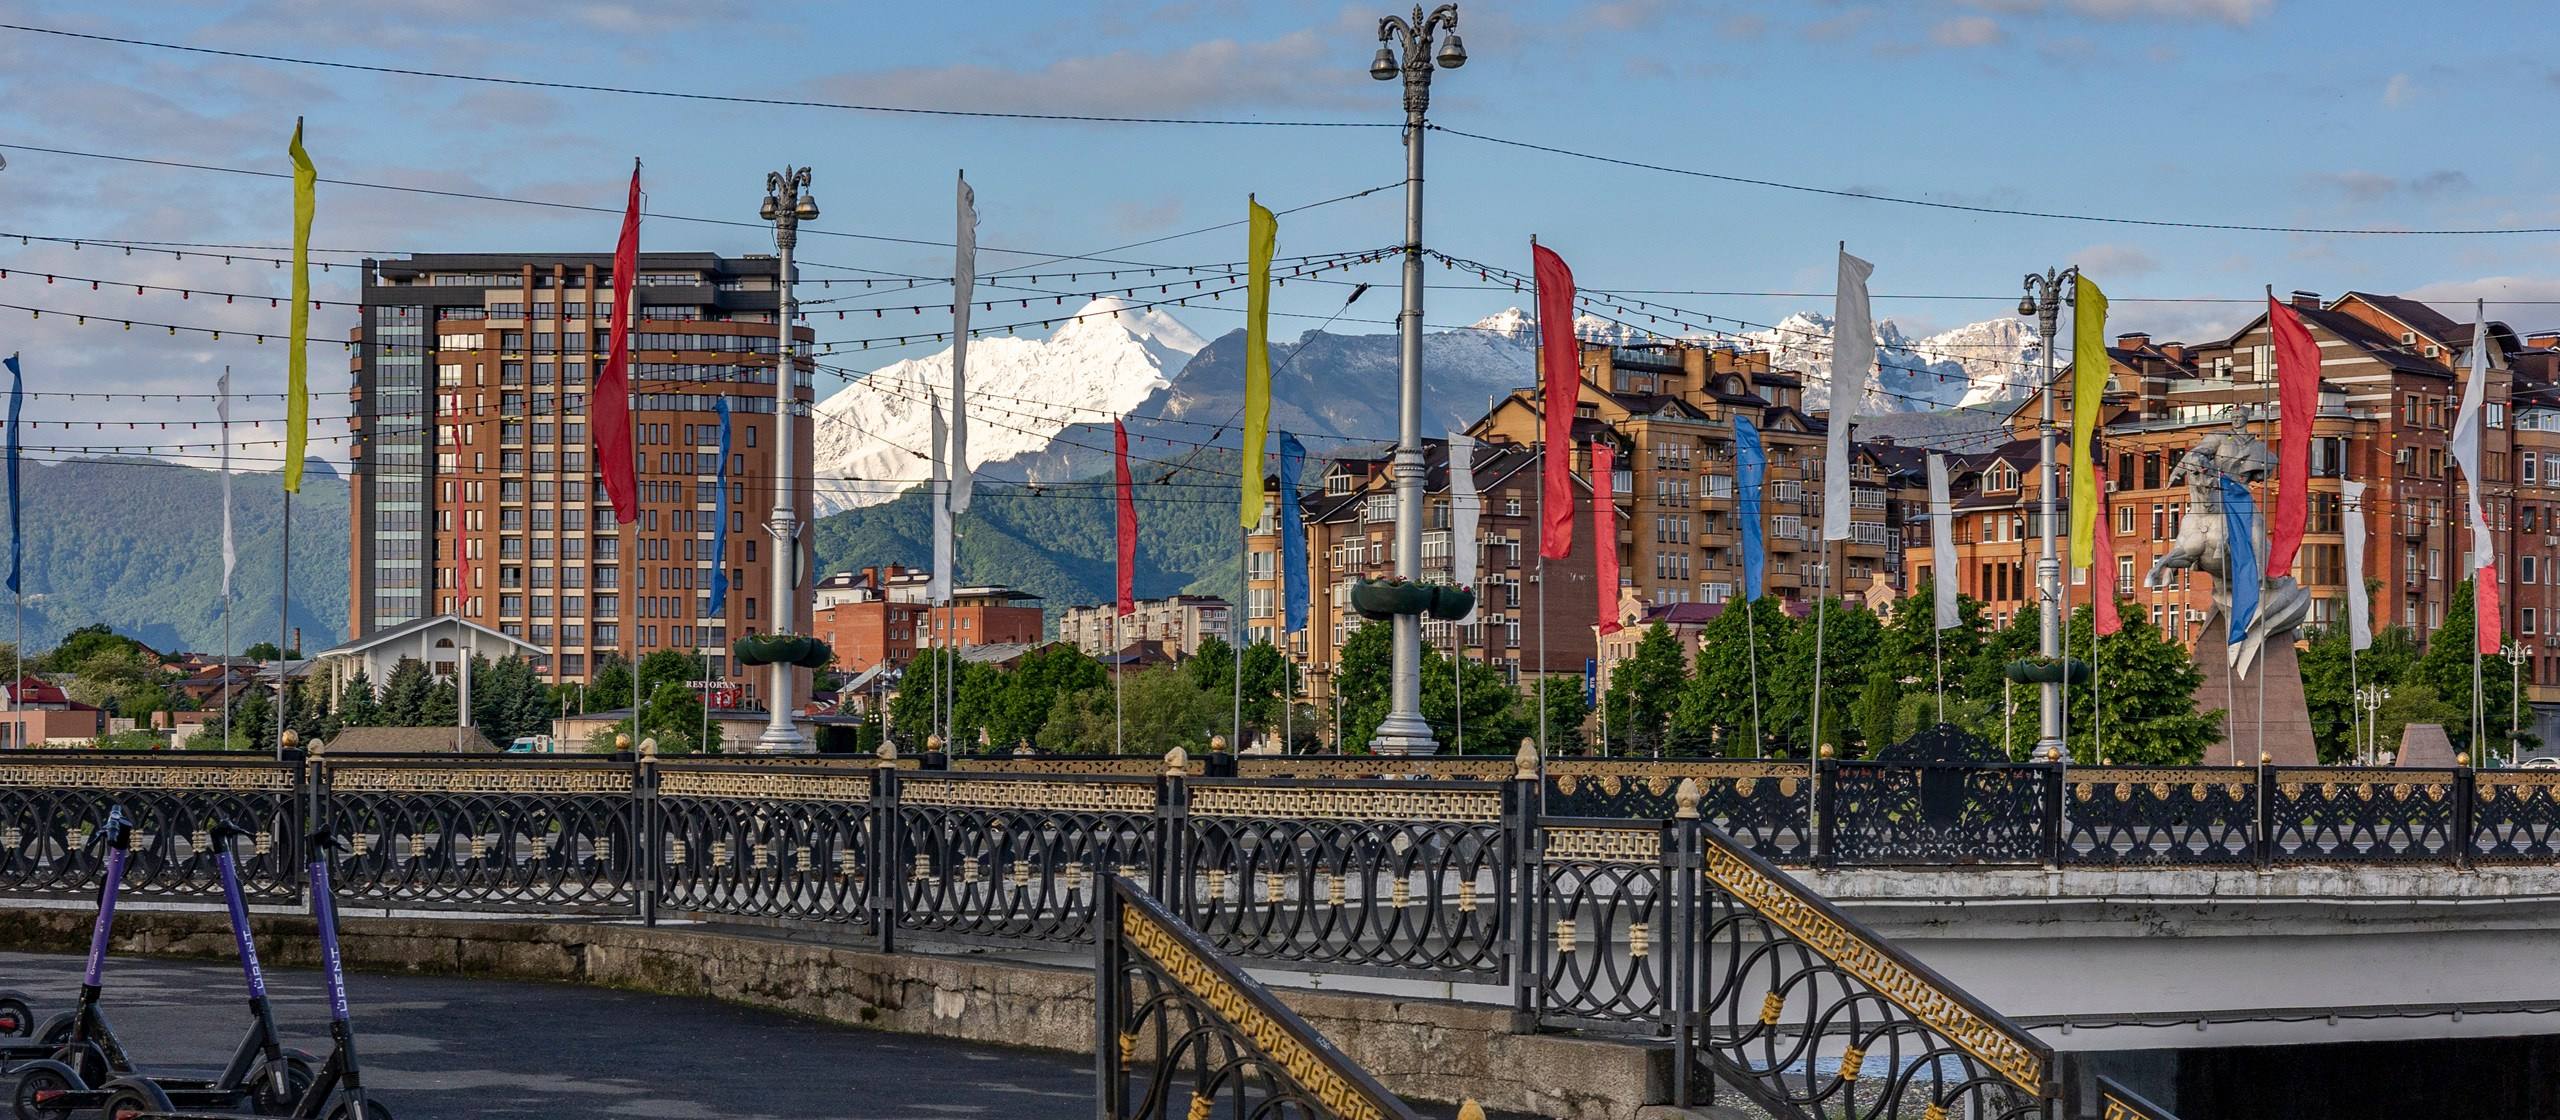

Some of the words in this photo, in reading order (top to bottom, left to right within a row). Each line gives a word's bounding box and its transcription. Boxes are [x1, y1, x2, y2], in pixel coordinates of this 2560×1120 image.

[685, 680, 736, 689] RESTORAN
[242, 930, 264, 989] ÜRENT
[330, 947, 348, 1012] ÜRENT
